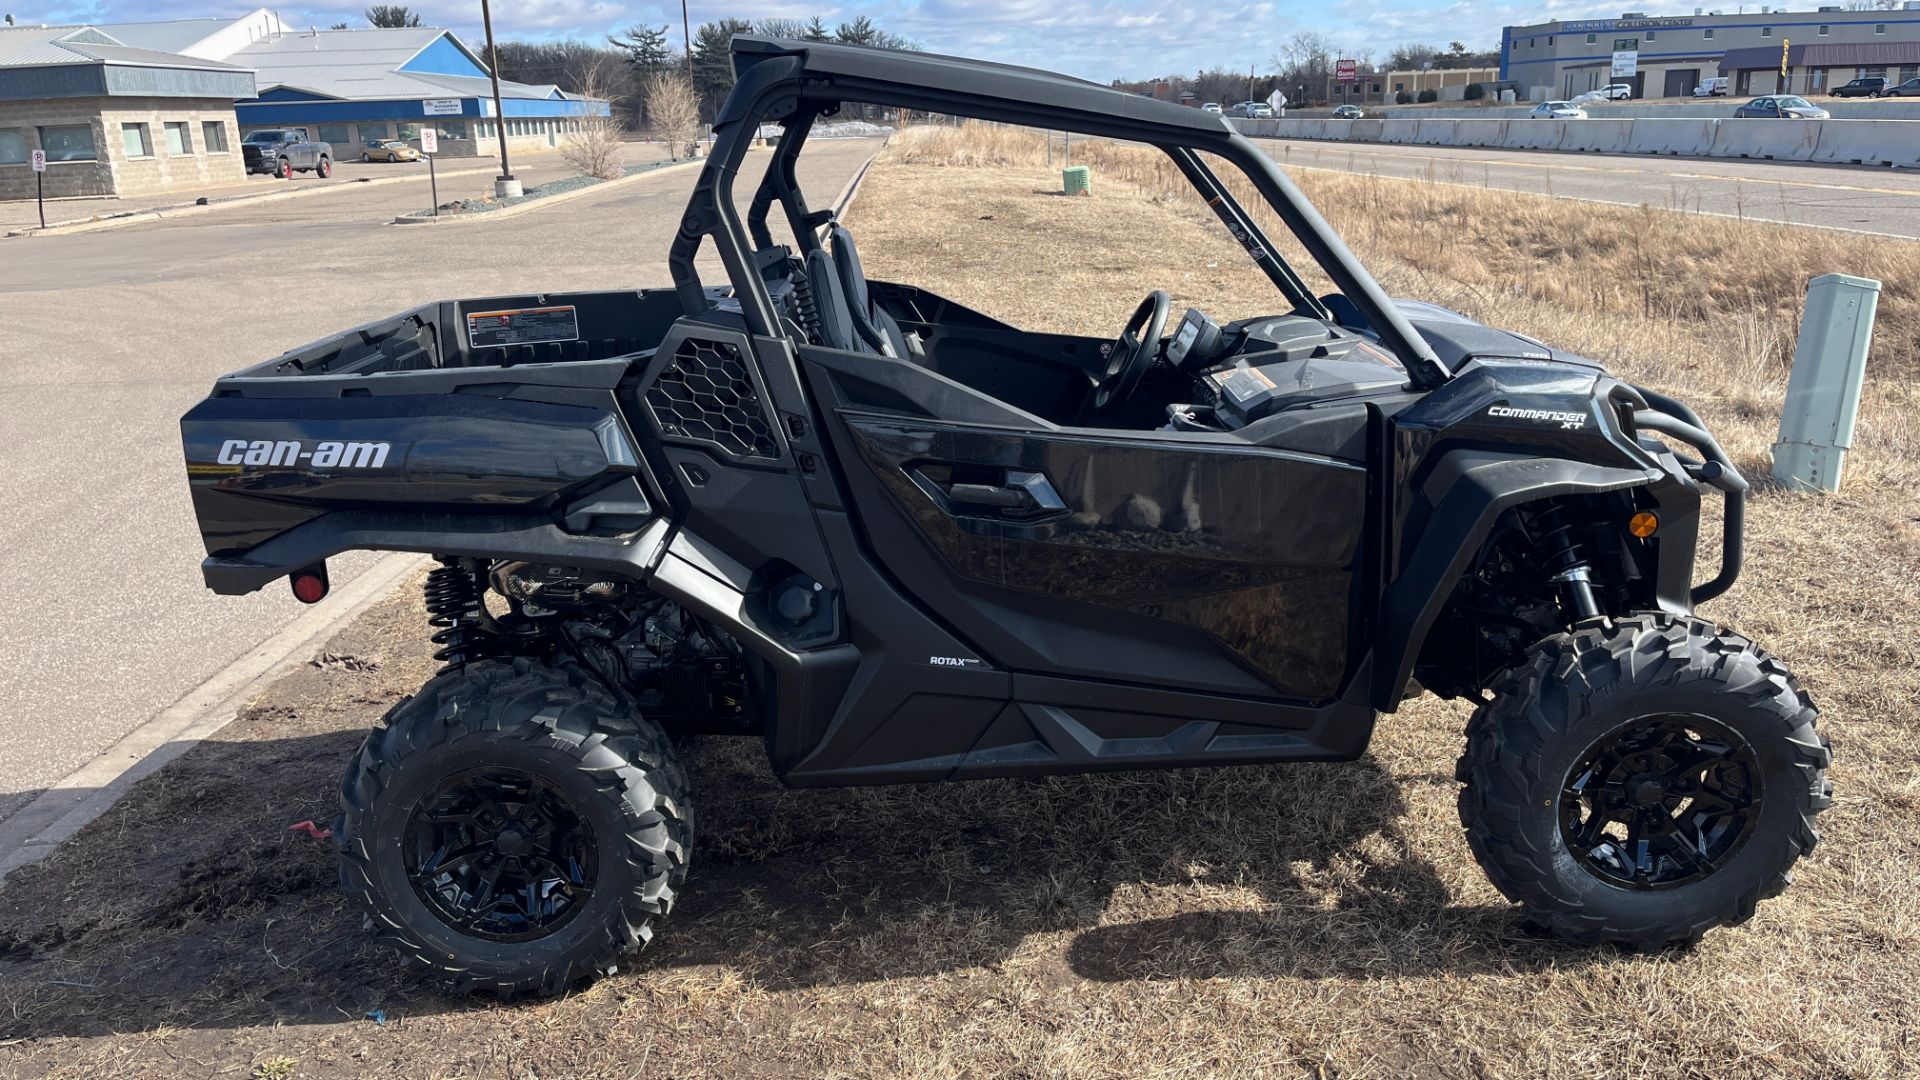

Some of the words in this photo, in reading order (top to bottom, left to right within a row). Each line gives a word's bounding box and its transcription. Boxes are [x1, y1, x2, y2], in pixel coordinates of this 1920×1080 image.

[1617, 19, 1660, 28] COLLISION
[1661, 18, 1693, 26] CENTER
[1337, 61, 1355, 70] PAWN
[1488, 406, 1587, 422] COMMANDER
[1560, 421, 1584, 429] XT
[217, 439, 391, 469] can-am
[930, 656, 965, 666] ROTAX
